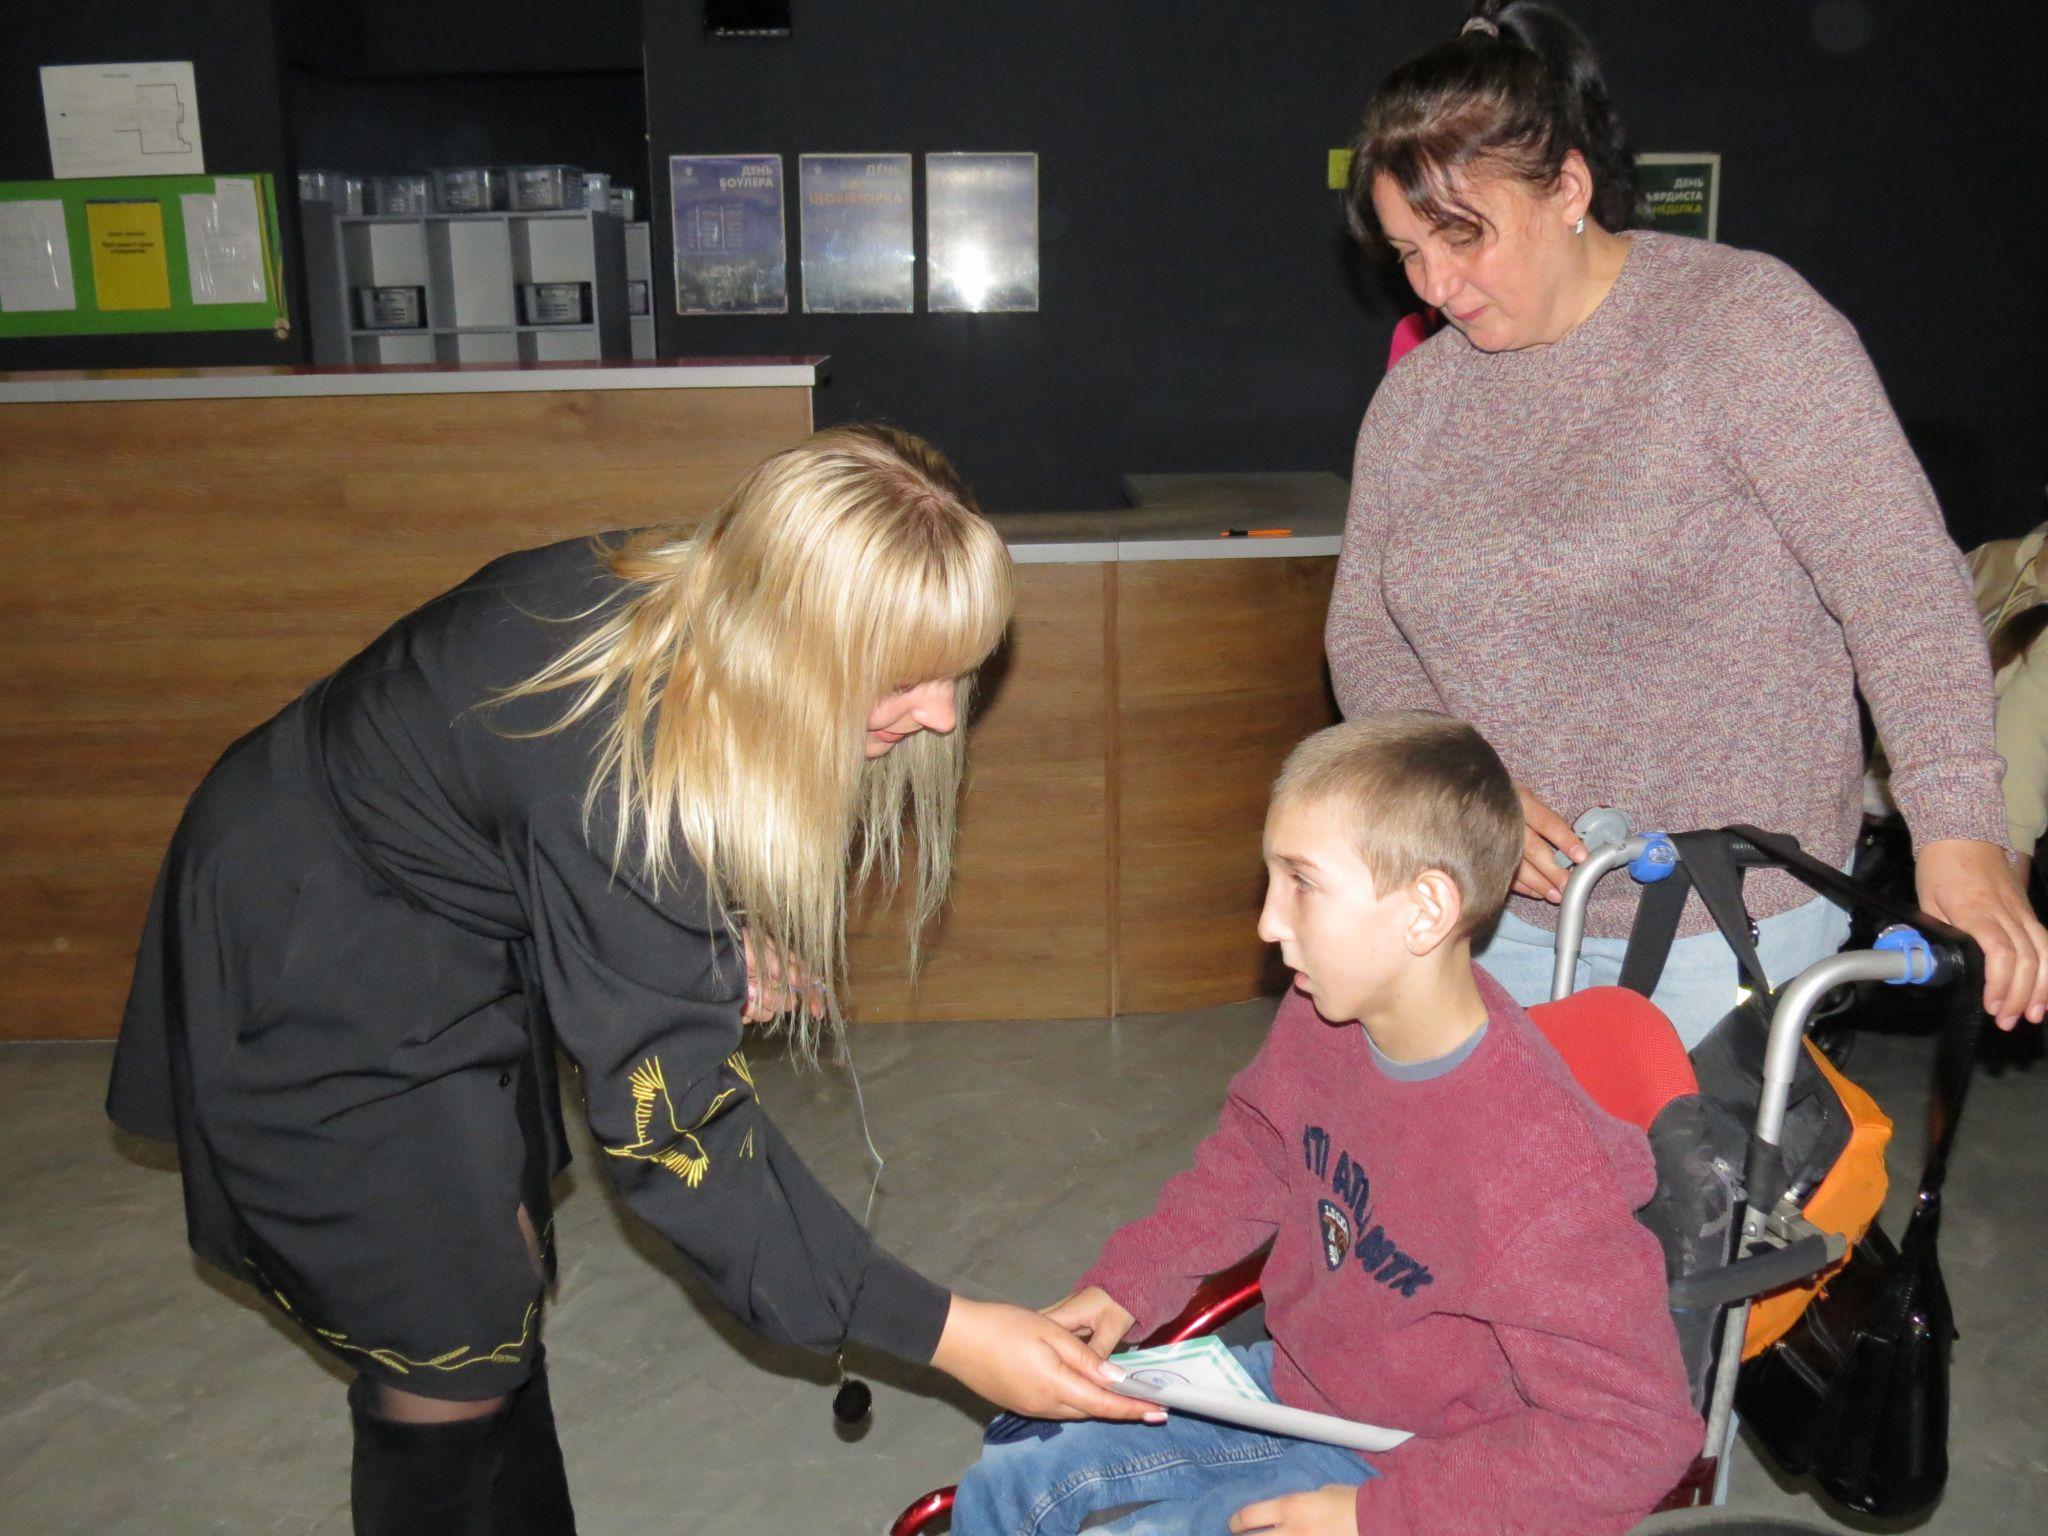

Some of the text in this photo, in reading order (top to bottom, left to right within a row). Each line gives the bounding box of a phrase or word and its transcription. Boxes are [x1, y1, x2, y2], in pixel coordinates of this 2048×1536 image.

[741, 165, 773, 177] ДЕНЬ
[720, 177, 773, 189] БОУЛЕРА
[1674, 178, 1704, 189] ДЕНЬ
